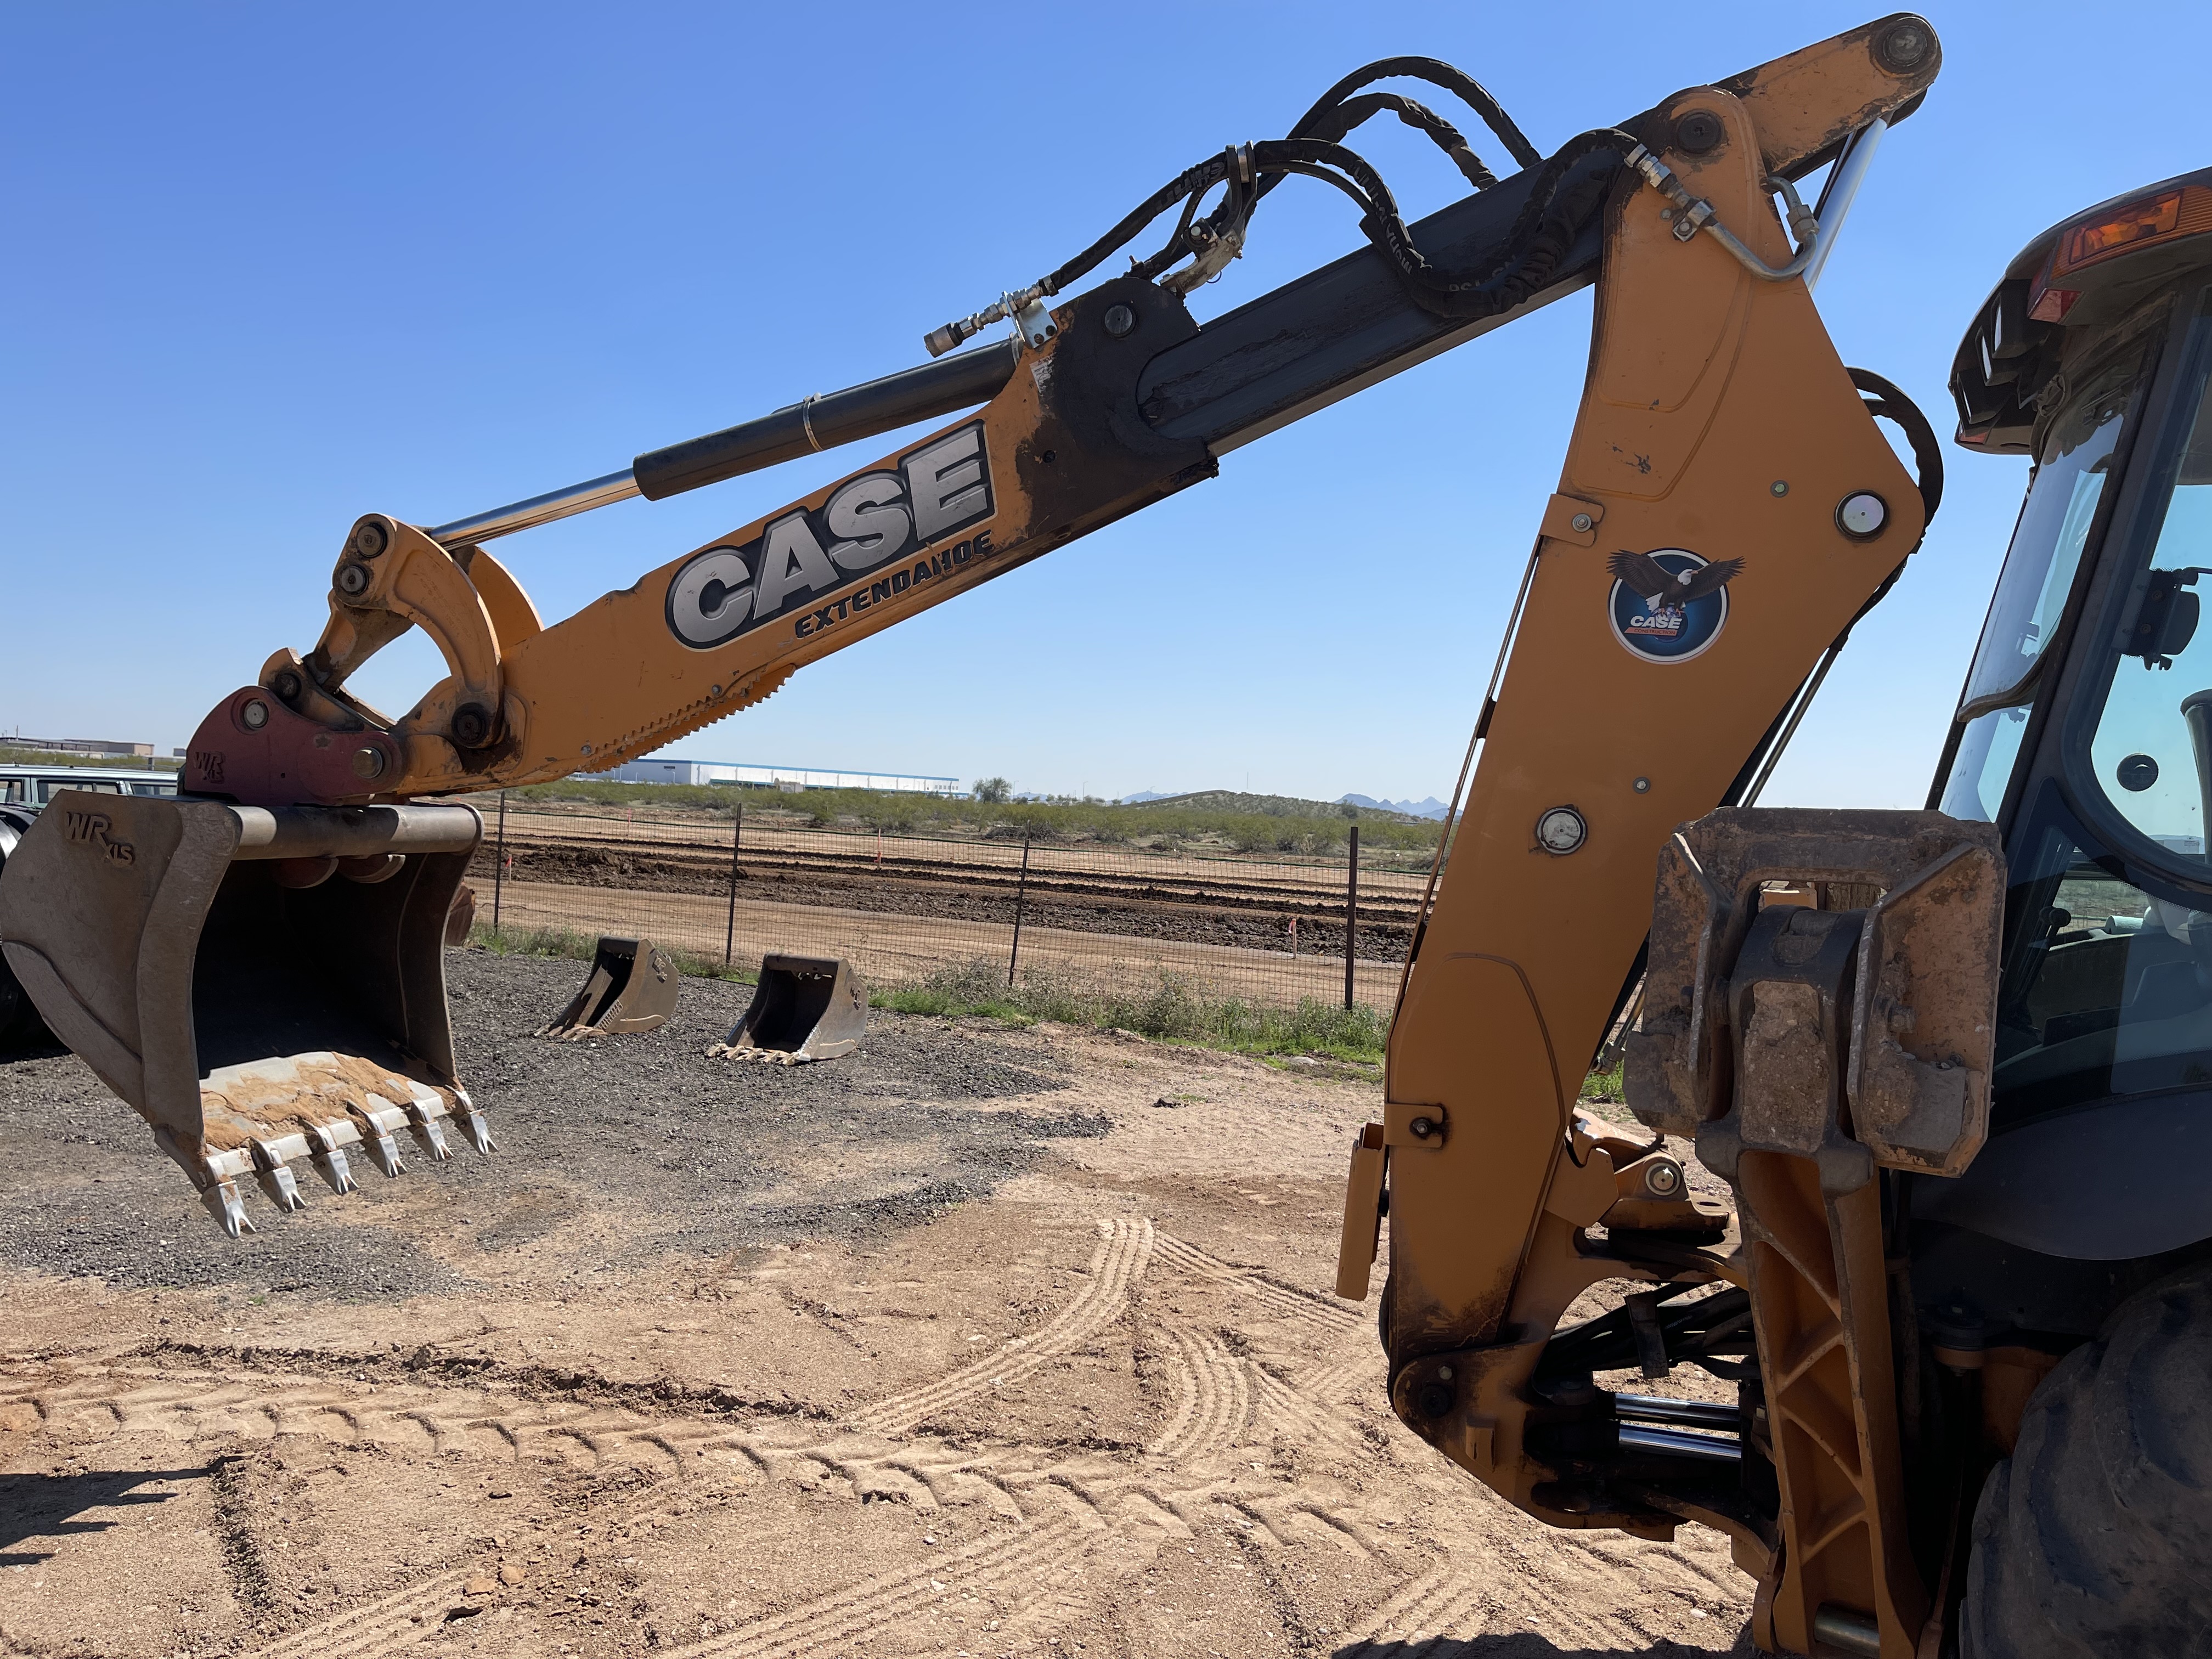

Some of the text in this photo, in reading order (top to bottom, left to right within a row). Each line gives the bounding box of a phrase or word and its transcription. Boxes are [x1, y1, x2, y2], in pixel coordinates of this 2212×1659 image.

[669, 425, 991, 646] CASE
[795, 529, 996, 639] EXTENDAHOE
[1630, 614, 1683, 629] CASE
[65, 812, 111, 845] WR
